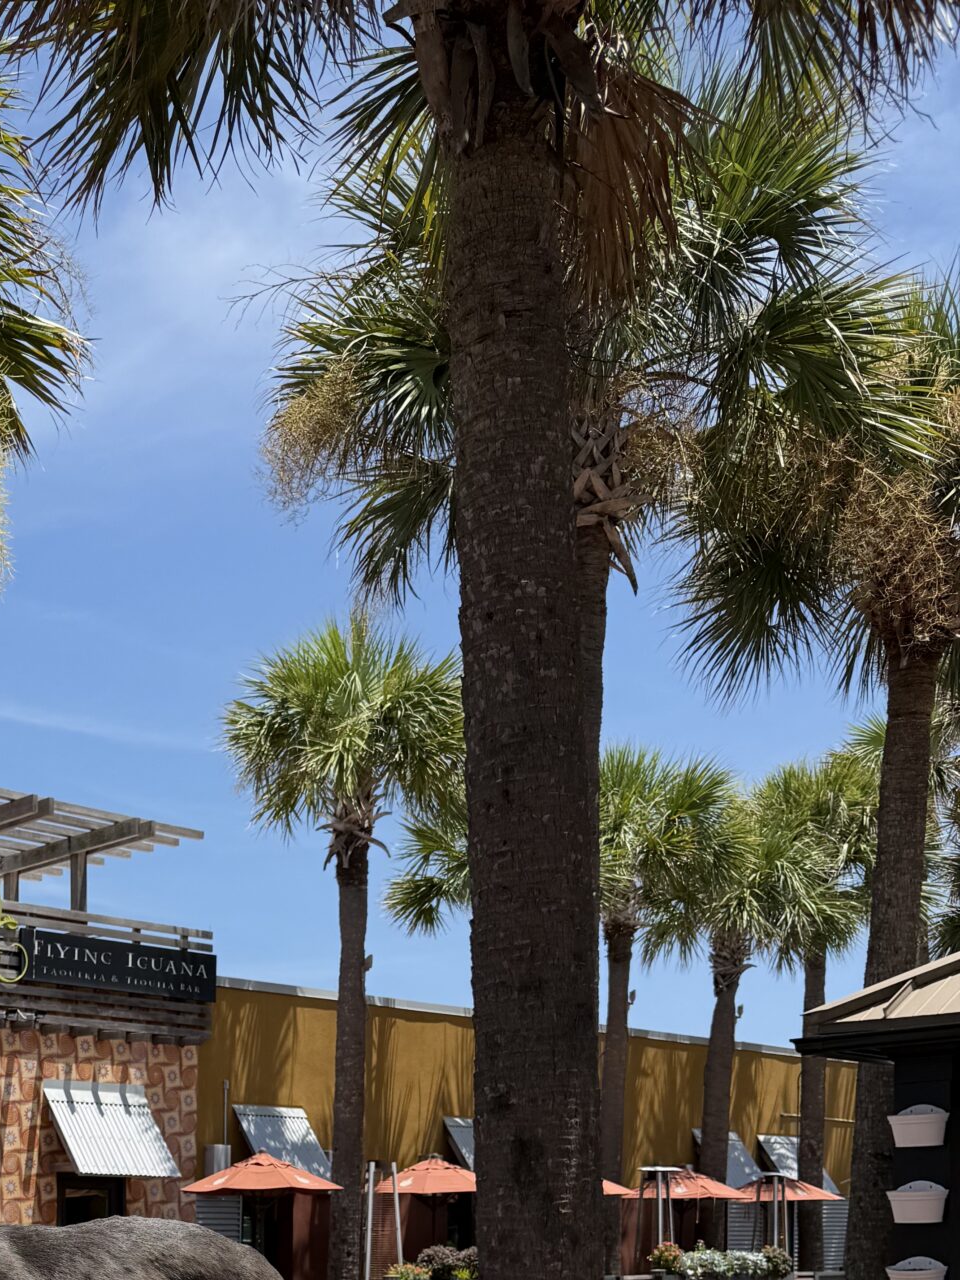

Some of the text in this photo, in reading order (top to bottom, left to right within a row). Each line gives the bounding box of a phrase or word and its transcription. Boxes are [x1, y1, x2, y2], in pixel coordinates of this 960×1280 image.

[34, 939, 208, 979] FLYING IGUANA
[180, 983, 201, 994] BAR
